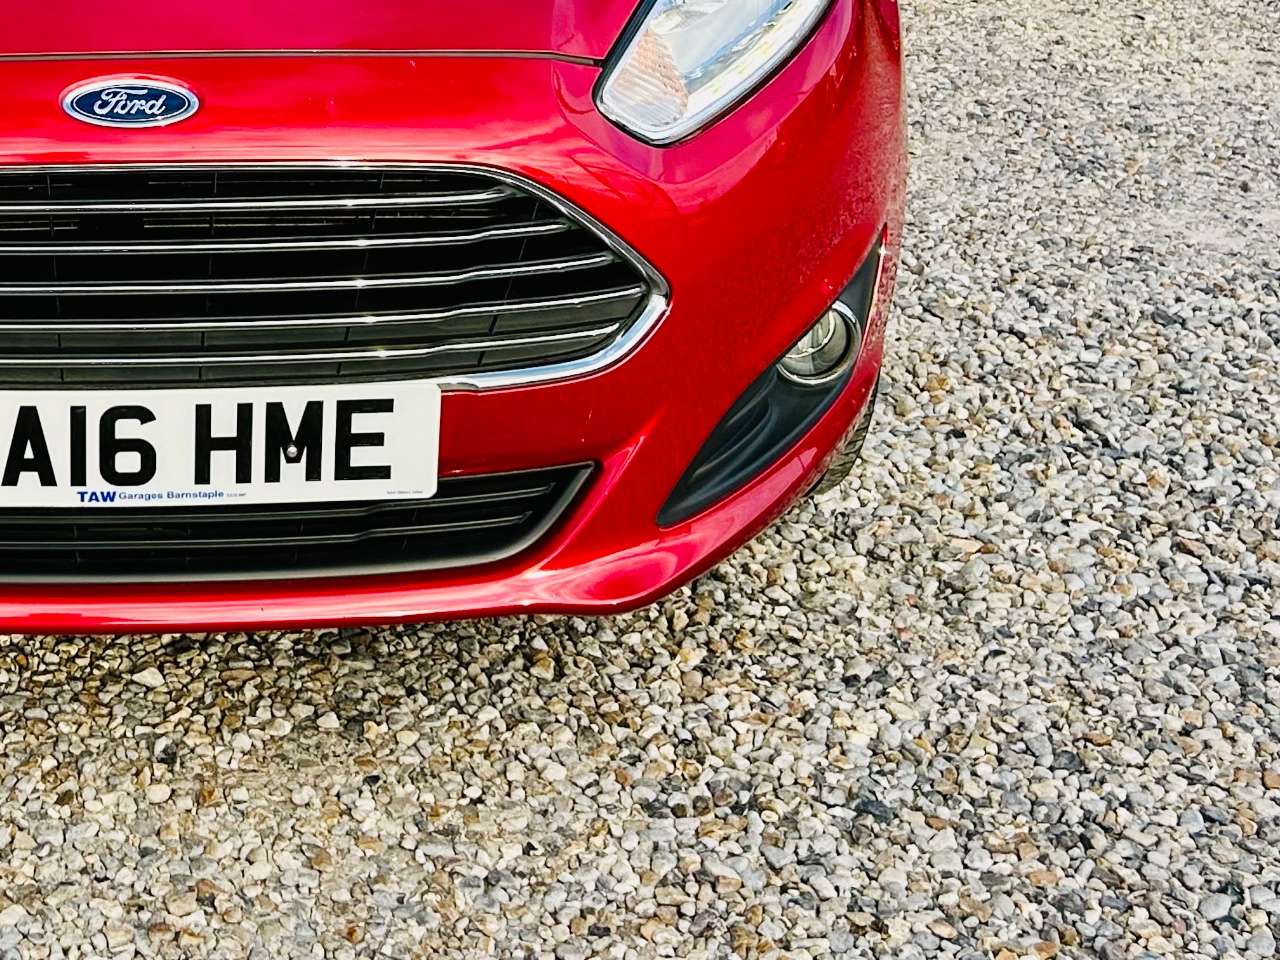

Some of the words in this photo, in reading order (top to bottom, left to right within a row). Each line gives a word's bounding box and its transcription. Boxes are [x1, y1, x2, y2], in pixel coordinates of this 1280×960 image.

[93, 88, 167, 115] Ford
[194, 398, 395, 485] HME
[76, 491, 117, 503] TAW
[118, 491, 163, 501] Garages
[166, 490, 225, 500] Barnstaple
